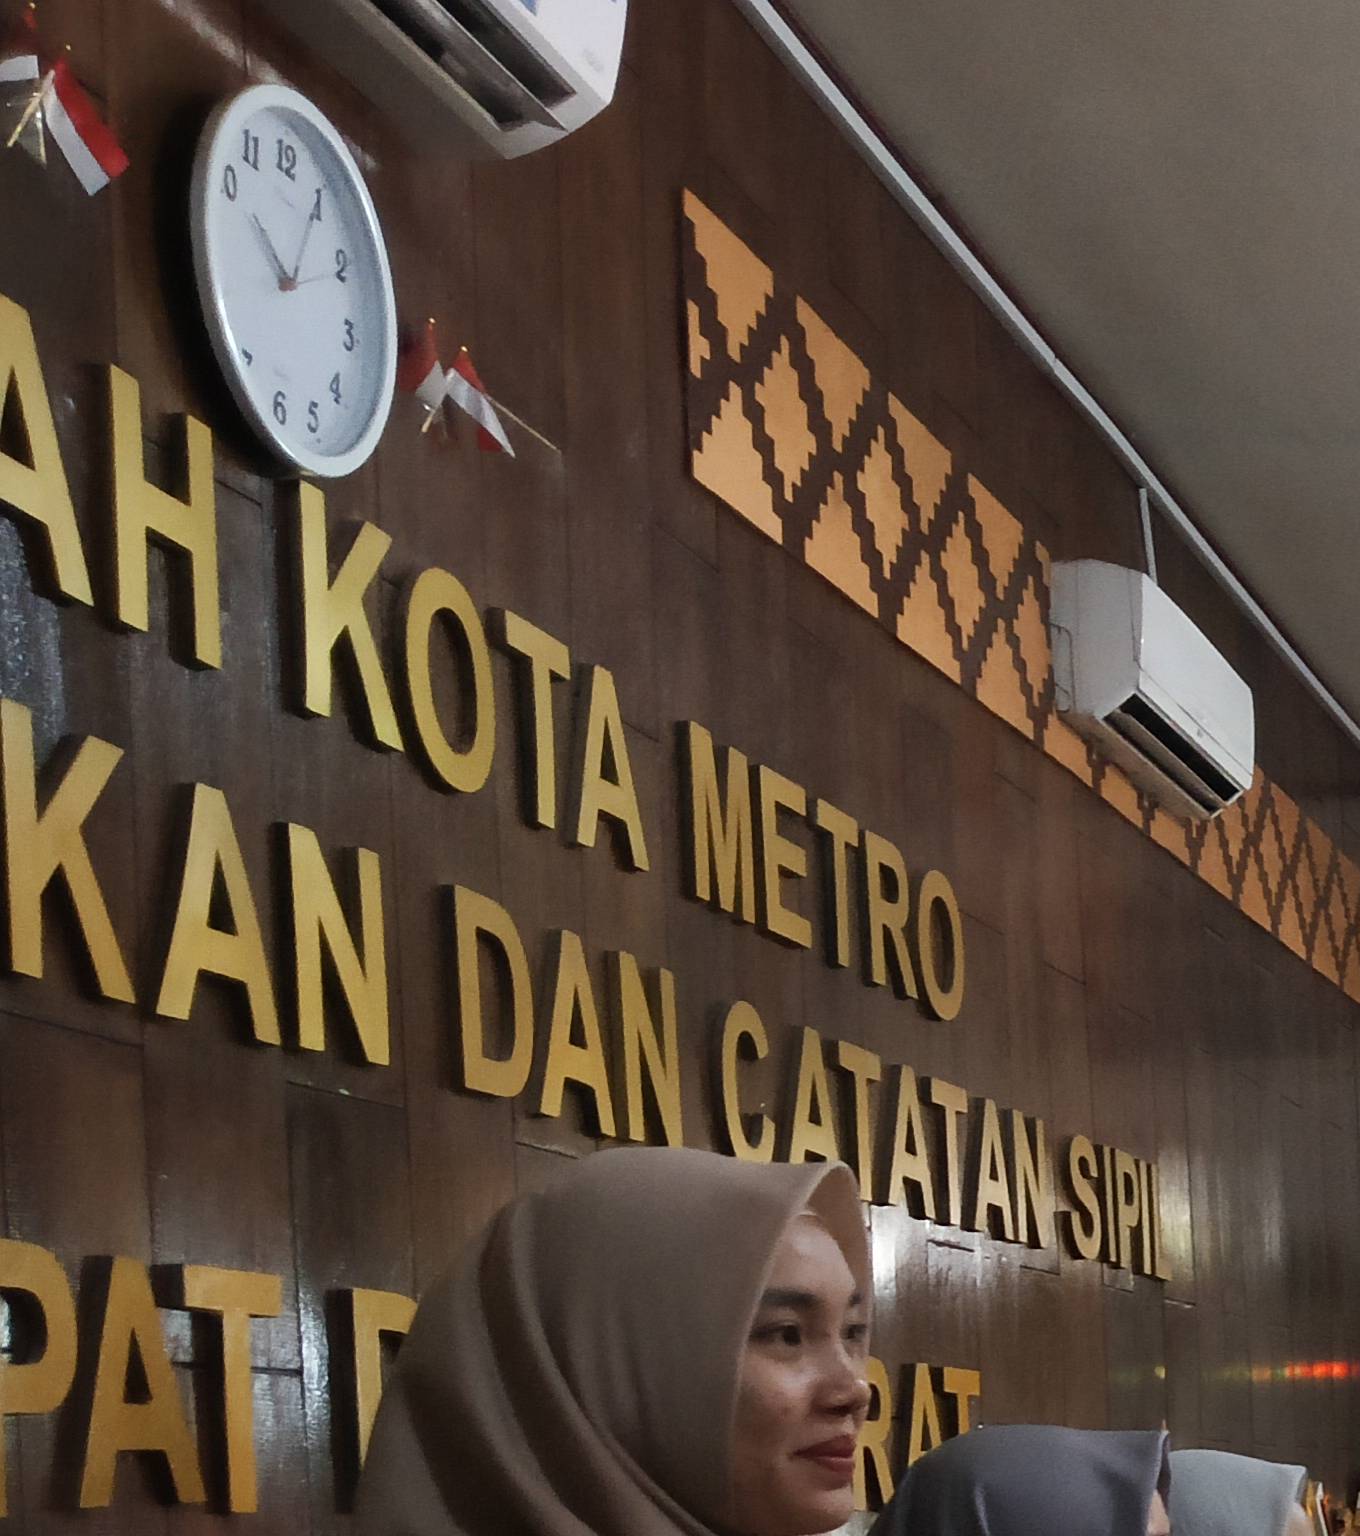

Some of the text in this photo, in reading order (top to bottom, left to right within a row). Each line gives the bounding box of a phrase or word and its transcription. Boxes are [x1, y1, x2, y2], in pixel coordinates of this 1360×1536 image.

[242, 128, 260, 171] 11
[276, 138, 297, 182] 12
[221, 164, 238, 202] 0
[309, 187, 323, 222] 1
[335, 248, 349, 284] 2
[344, 319, 355, 352] 3
[330, 371, 342, 405] 4
[273, 390, 287, 426] 6
[307, 400, 320, 434] 5
[300, 482, 650, 873] KOTA
[686, 720, 965, 1022] METRO
[0, 697, 1172, 1281] KAN DAN CATATAN SIPIL
